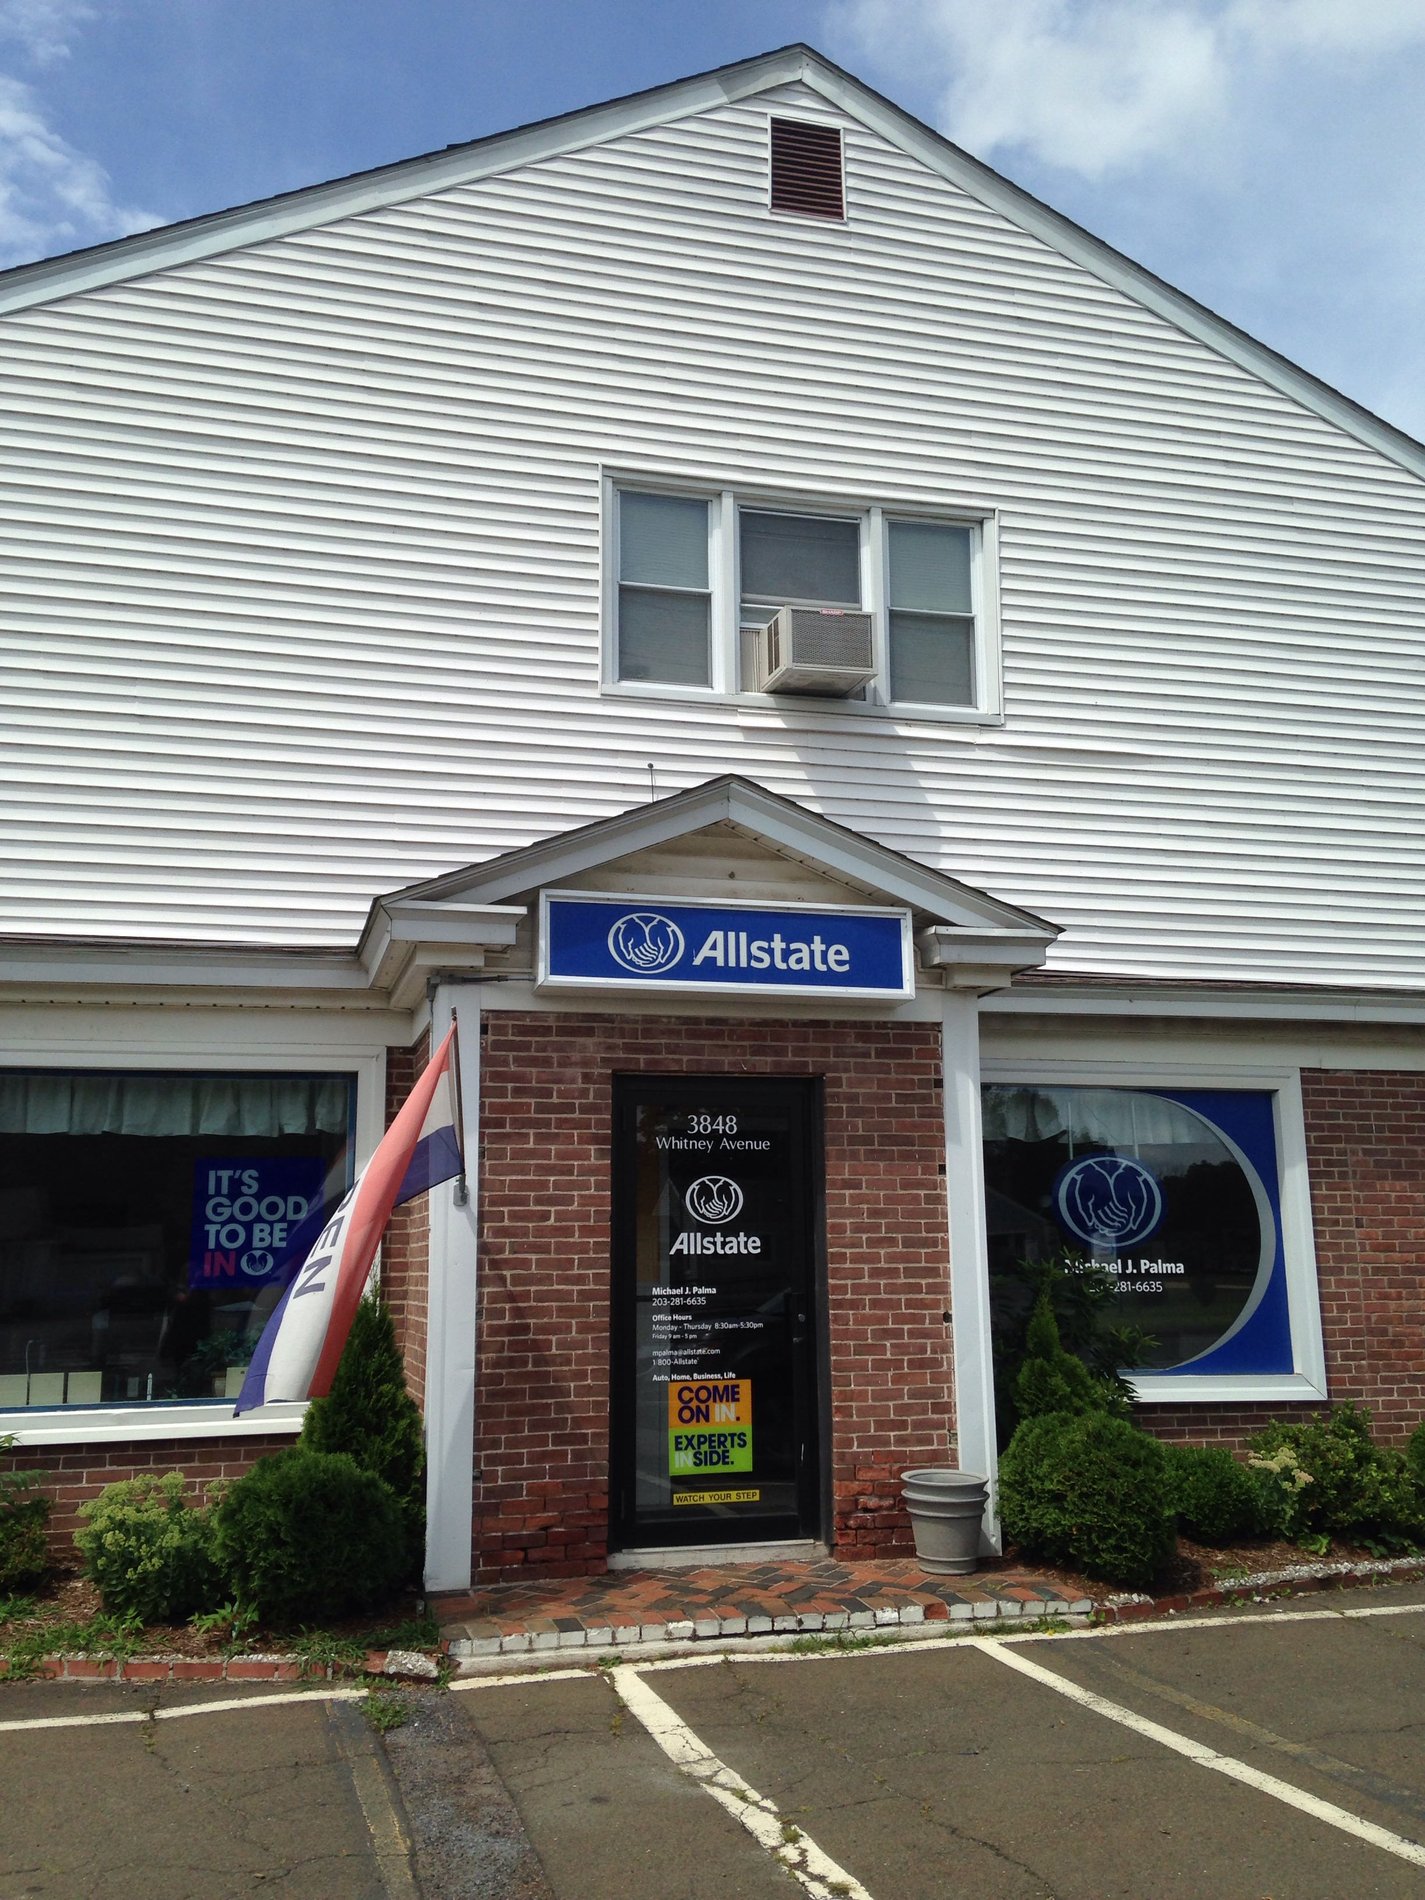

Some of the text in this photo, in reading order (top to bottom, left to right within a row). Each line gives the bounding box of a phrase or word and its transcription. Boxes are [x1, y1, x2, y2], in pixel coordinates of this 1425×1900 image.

[692, 931, 850, 972] Allstate
[687, 1115, 738, 1134] 3848
[656, 1136, 771, 1153] Whitney Avenue
[208, 1169, 260, 1195] IT'S
[205, 1195, 309, 1223] GOOD
[204, 1222, 288, 1249] TO BE
[669, 1232, 762, 1255] Allstate
[203, 1251, 236, 1277] IN
[1125, 1259, 1138, 1274] J.
[1140, 1259, 1185, 1274] Palma
[651, 1286, 717, 1296] Michael J. Palma
[1089, 1280, 1163, 1293] -281-6635
[652, 1297, 707, 1307] 203-281-6635
[652, 1314, 672, 1322] Office
[652, 1324, 678, 1332] Monday
[683, 1323, 712, 1331] Thursday
[652, 1333, 668, 1341] Friday
[652, 1348, 721, 1357] mpalma@allstate.com
[652, 1358, 698, 1366] 1800-Allstate
[652, 1371, 736, 1382] Auto, Home, Business, Life
[677, 1384, 740, 1405] COME
[677, 1402, 740, 1424] ON IN.
[674, 1432, 747, 1452] EXPERTS
[674, 1449, 734, 1469] INSIDE.
[675, 1490, 758, 1503] WATCH YOUR STEP
